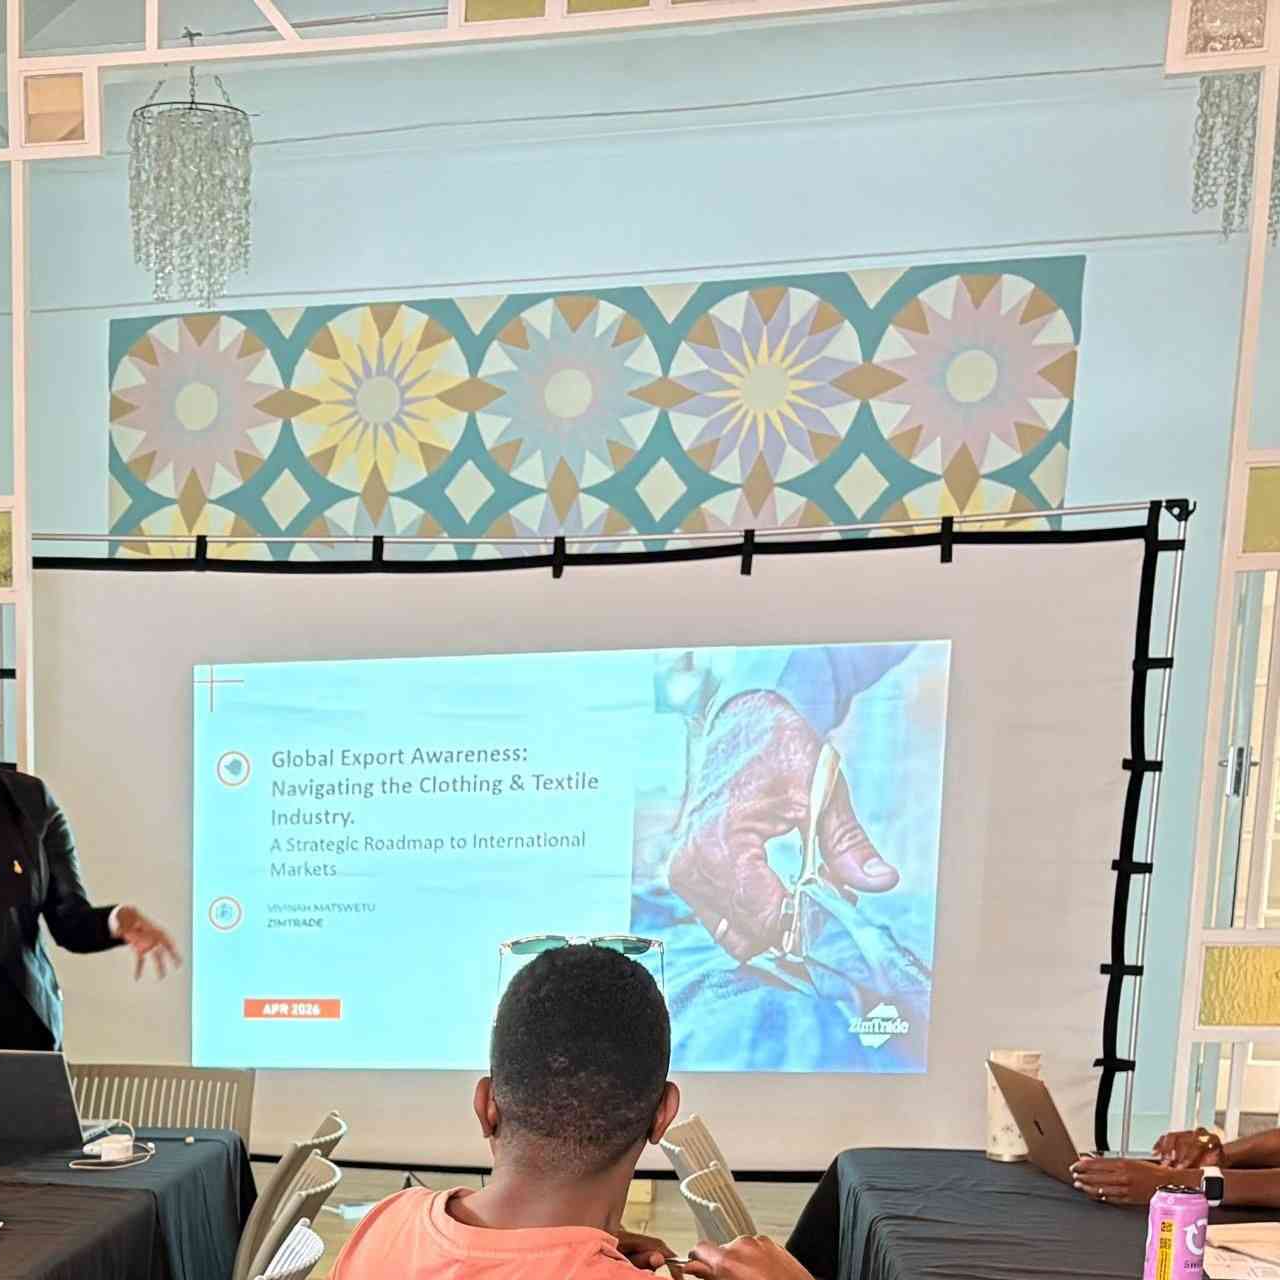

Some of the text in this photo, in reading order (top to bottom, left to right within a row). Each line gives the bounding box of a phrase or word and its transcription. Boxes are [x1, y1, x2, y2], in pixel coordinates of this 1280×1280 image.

[271, 746, 528, 770] Global Export Awareness:
[271, 771, 600, 800] Navigating the Clothing & Textile
[271, 807, 355, 829] Industry.
[270, 831, 586, 855] A Strategic Roadmap to International
[270, 861, 337, 878] Markets
[266, 918, 324, 929] ZIMTRADE
[262, 1003, 321, 1016] APR 2026
